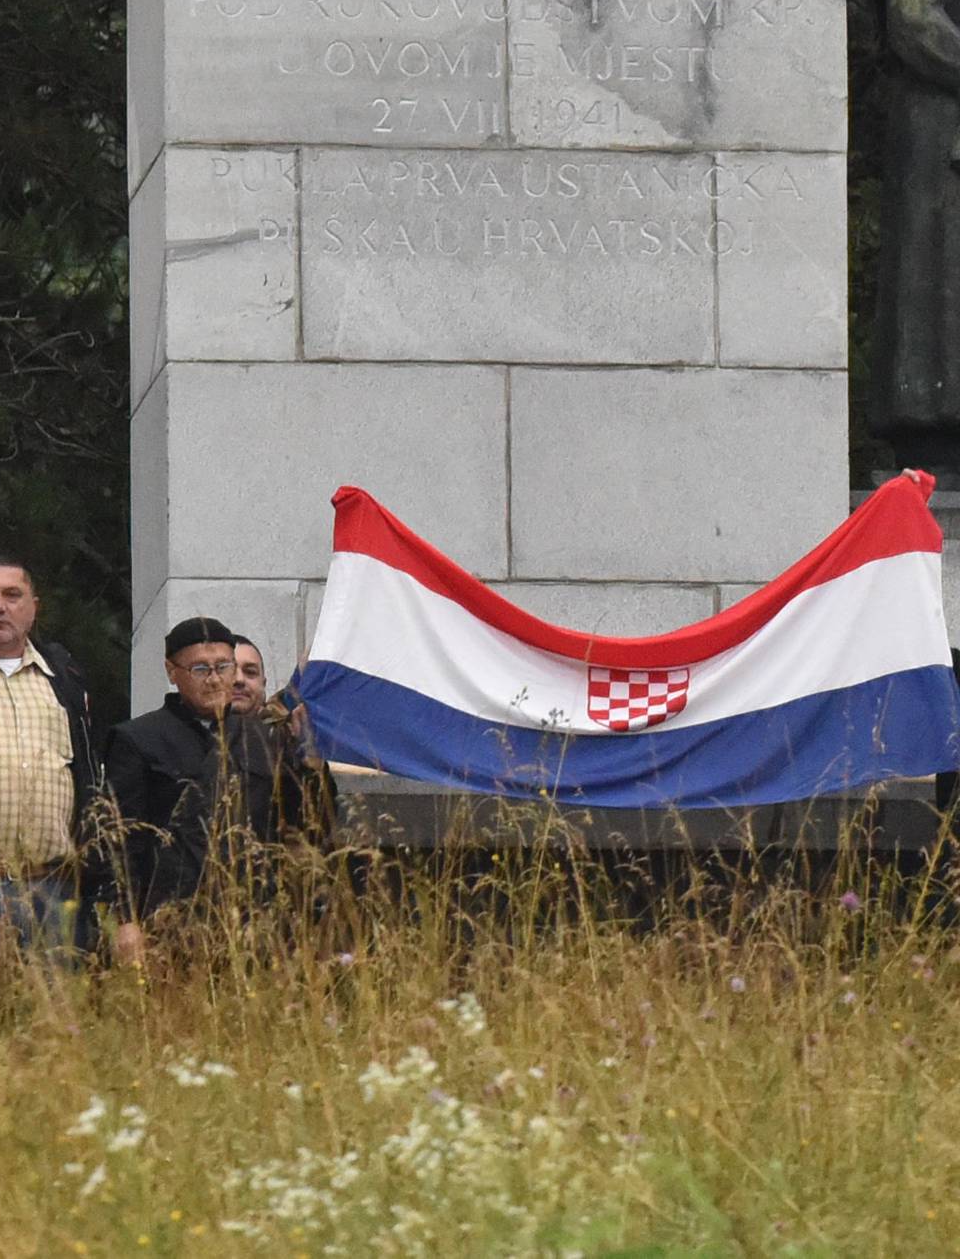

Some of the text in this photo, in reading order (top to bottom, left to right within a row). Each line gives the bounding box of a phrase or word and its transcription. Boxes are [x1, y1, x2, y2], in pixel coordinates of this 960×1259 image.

[487, 42, 537, 79] JE
[390, 160, 509, 198] PRVA
[482, 218, 754, 256] HRVATSKOJ
